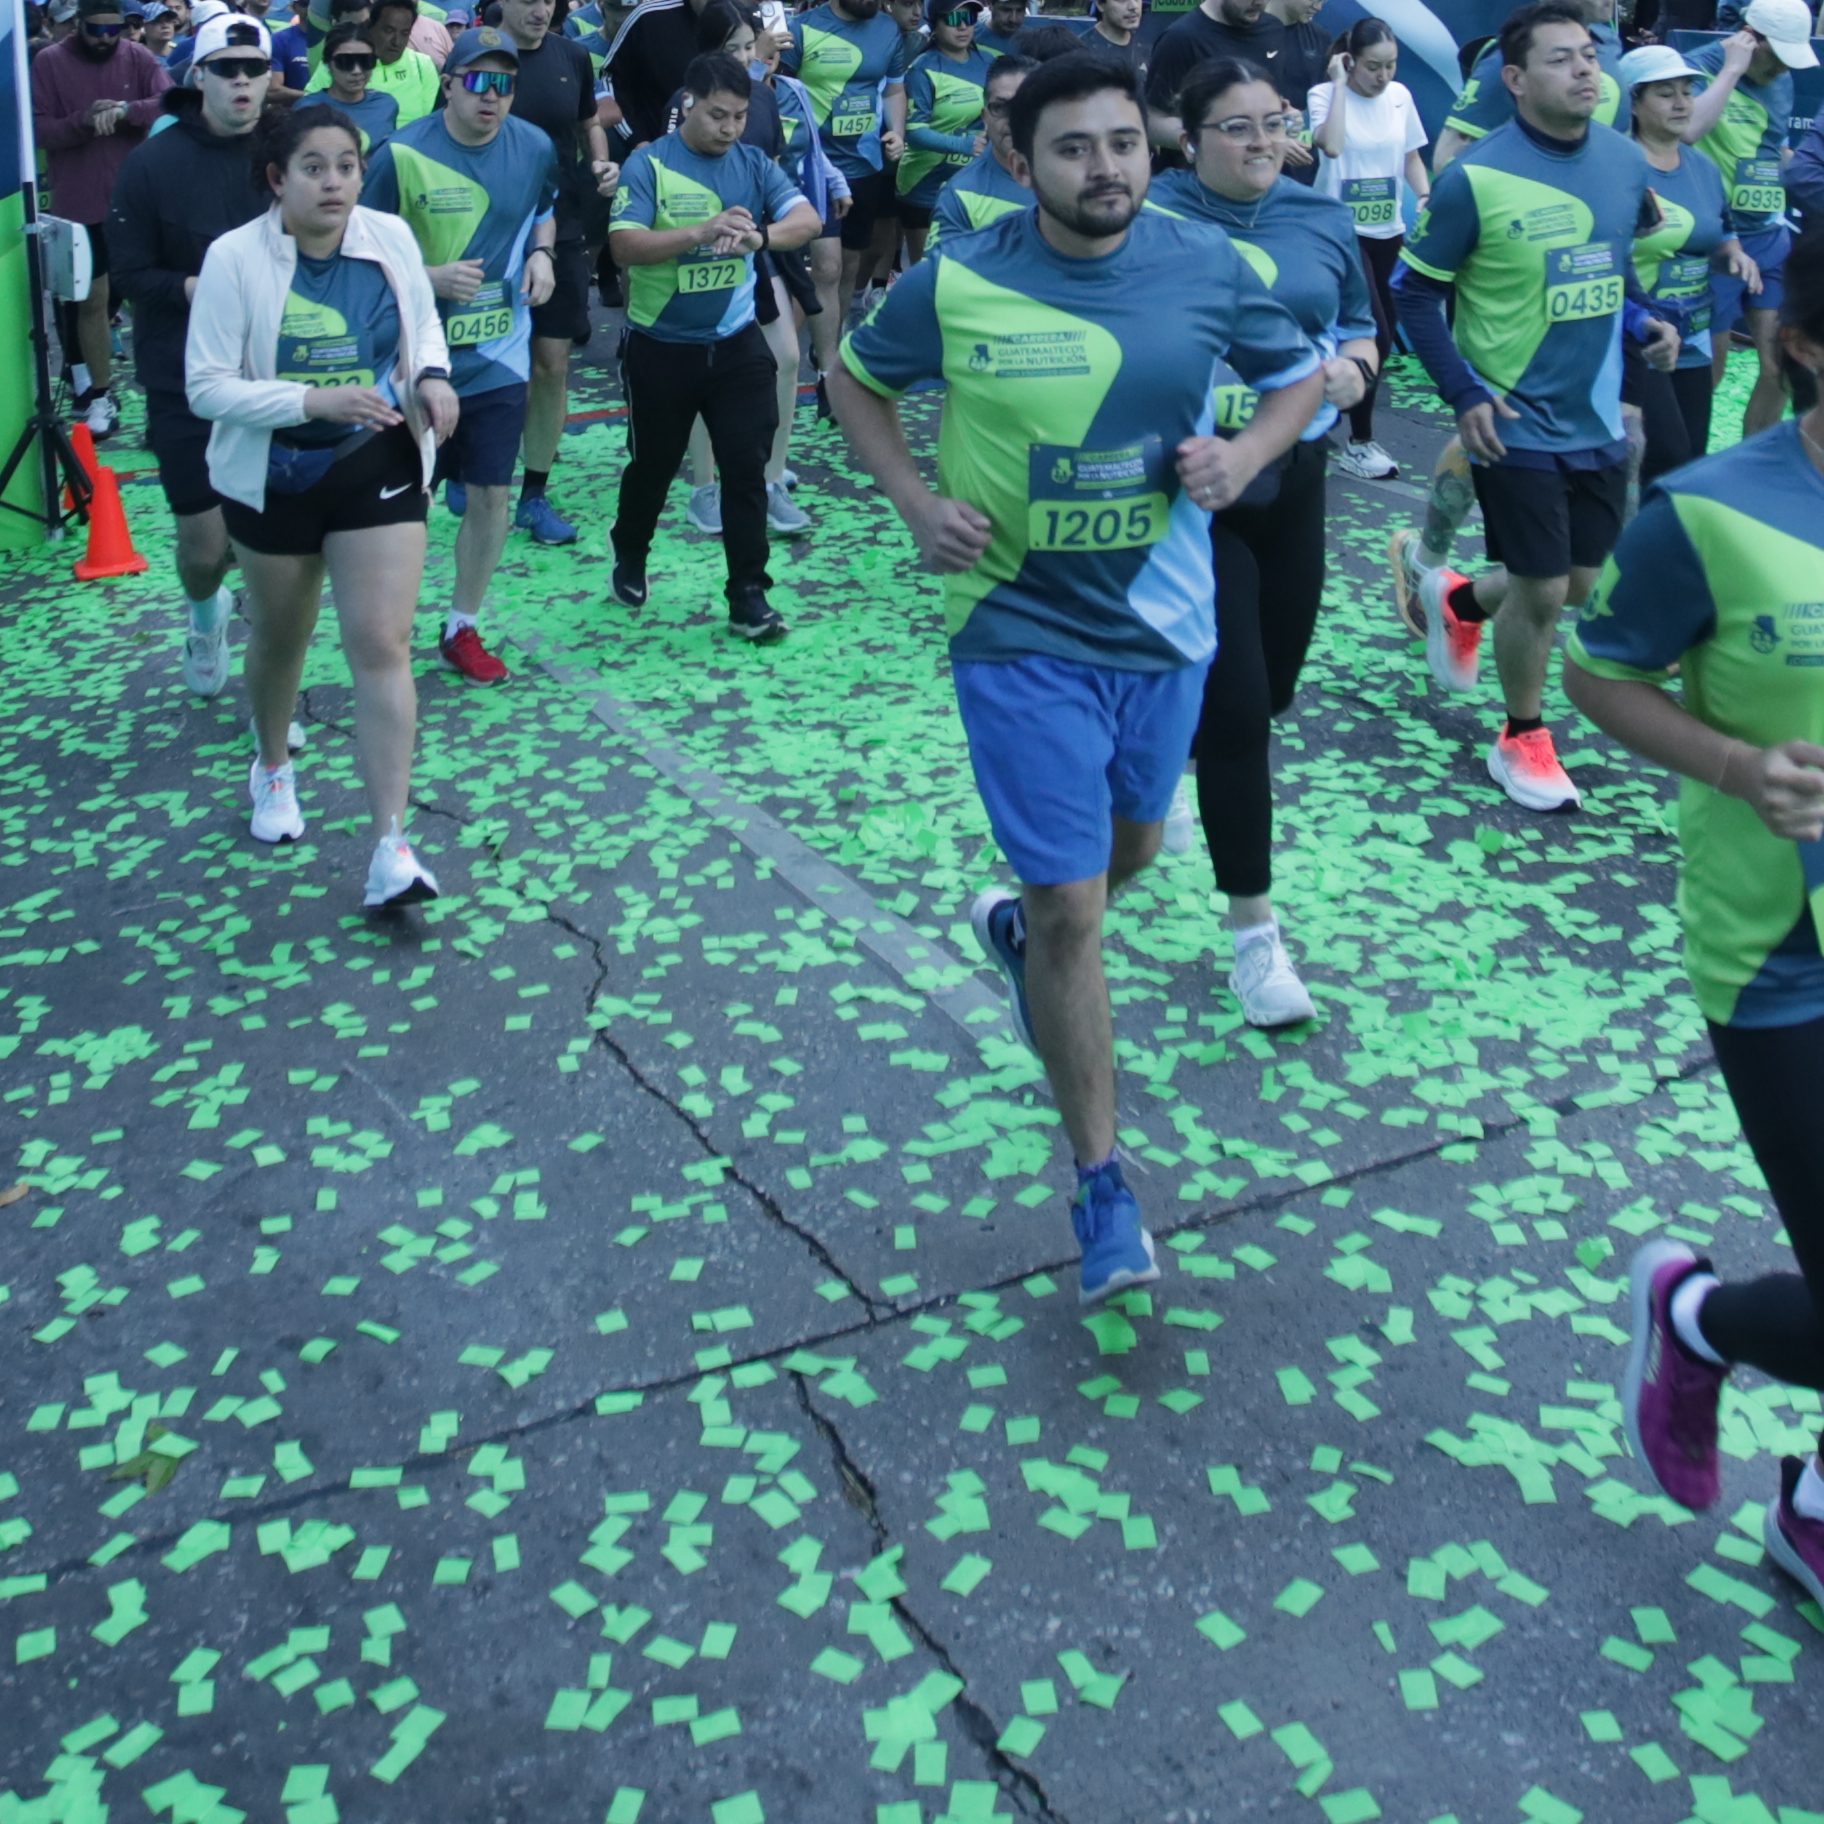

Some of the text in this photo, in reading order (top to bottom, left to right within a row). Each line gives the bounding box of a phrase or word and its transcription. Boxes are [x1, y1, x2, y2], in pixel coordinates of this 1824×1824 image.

[838, 116, 873, 133] 1457
[1352, 203, 1394, 223] 098
[1736, 189, 1783, 209] 0935
[687, 264, 736, 290] 1372
[1551, 281, 1620, 317] 0435
[450, 312, 511, 342] 0456
[1225, 392, 1261, 424] 15
[1046, 502, 1153, 547] 1205
